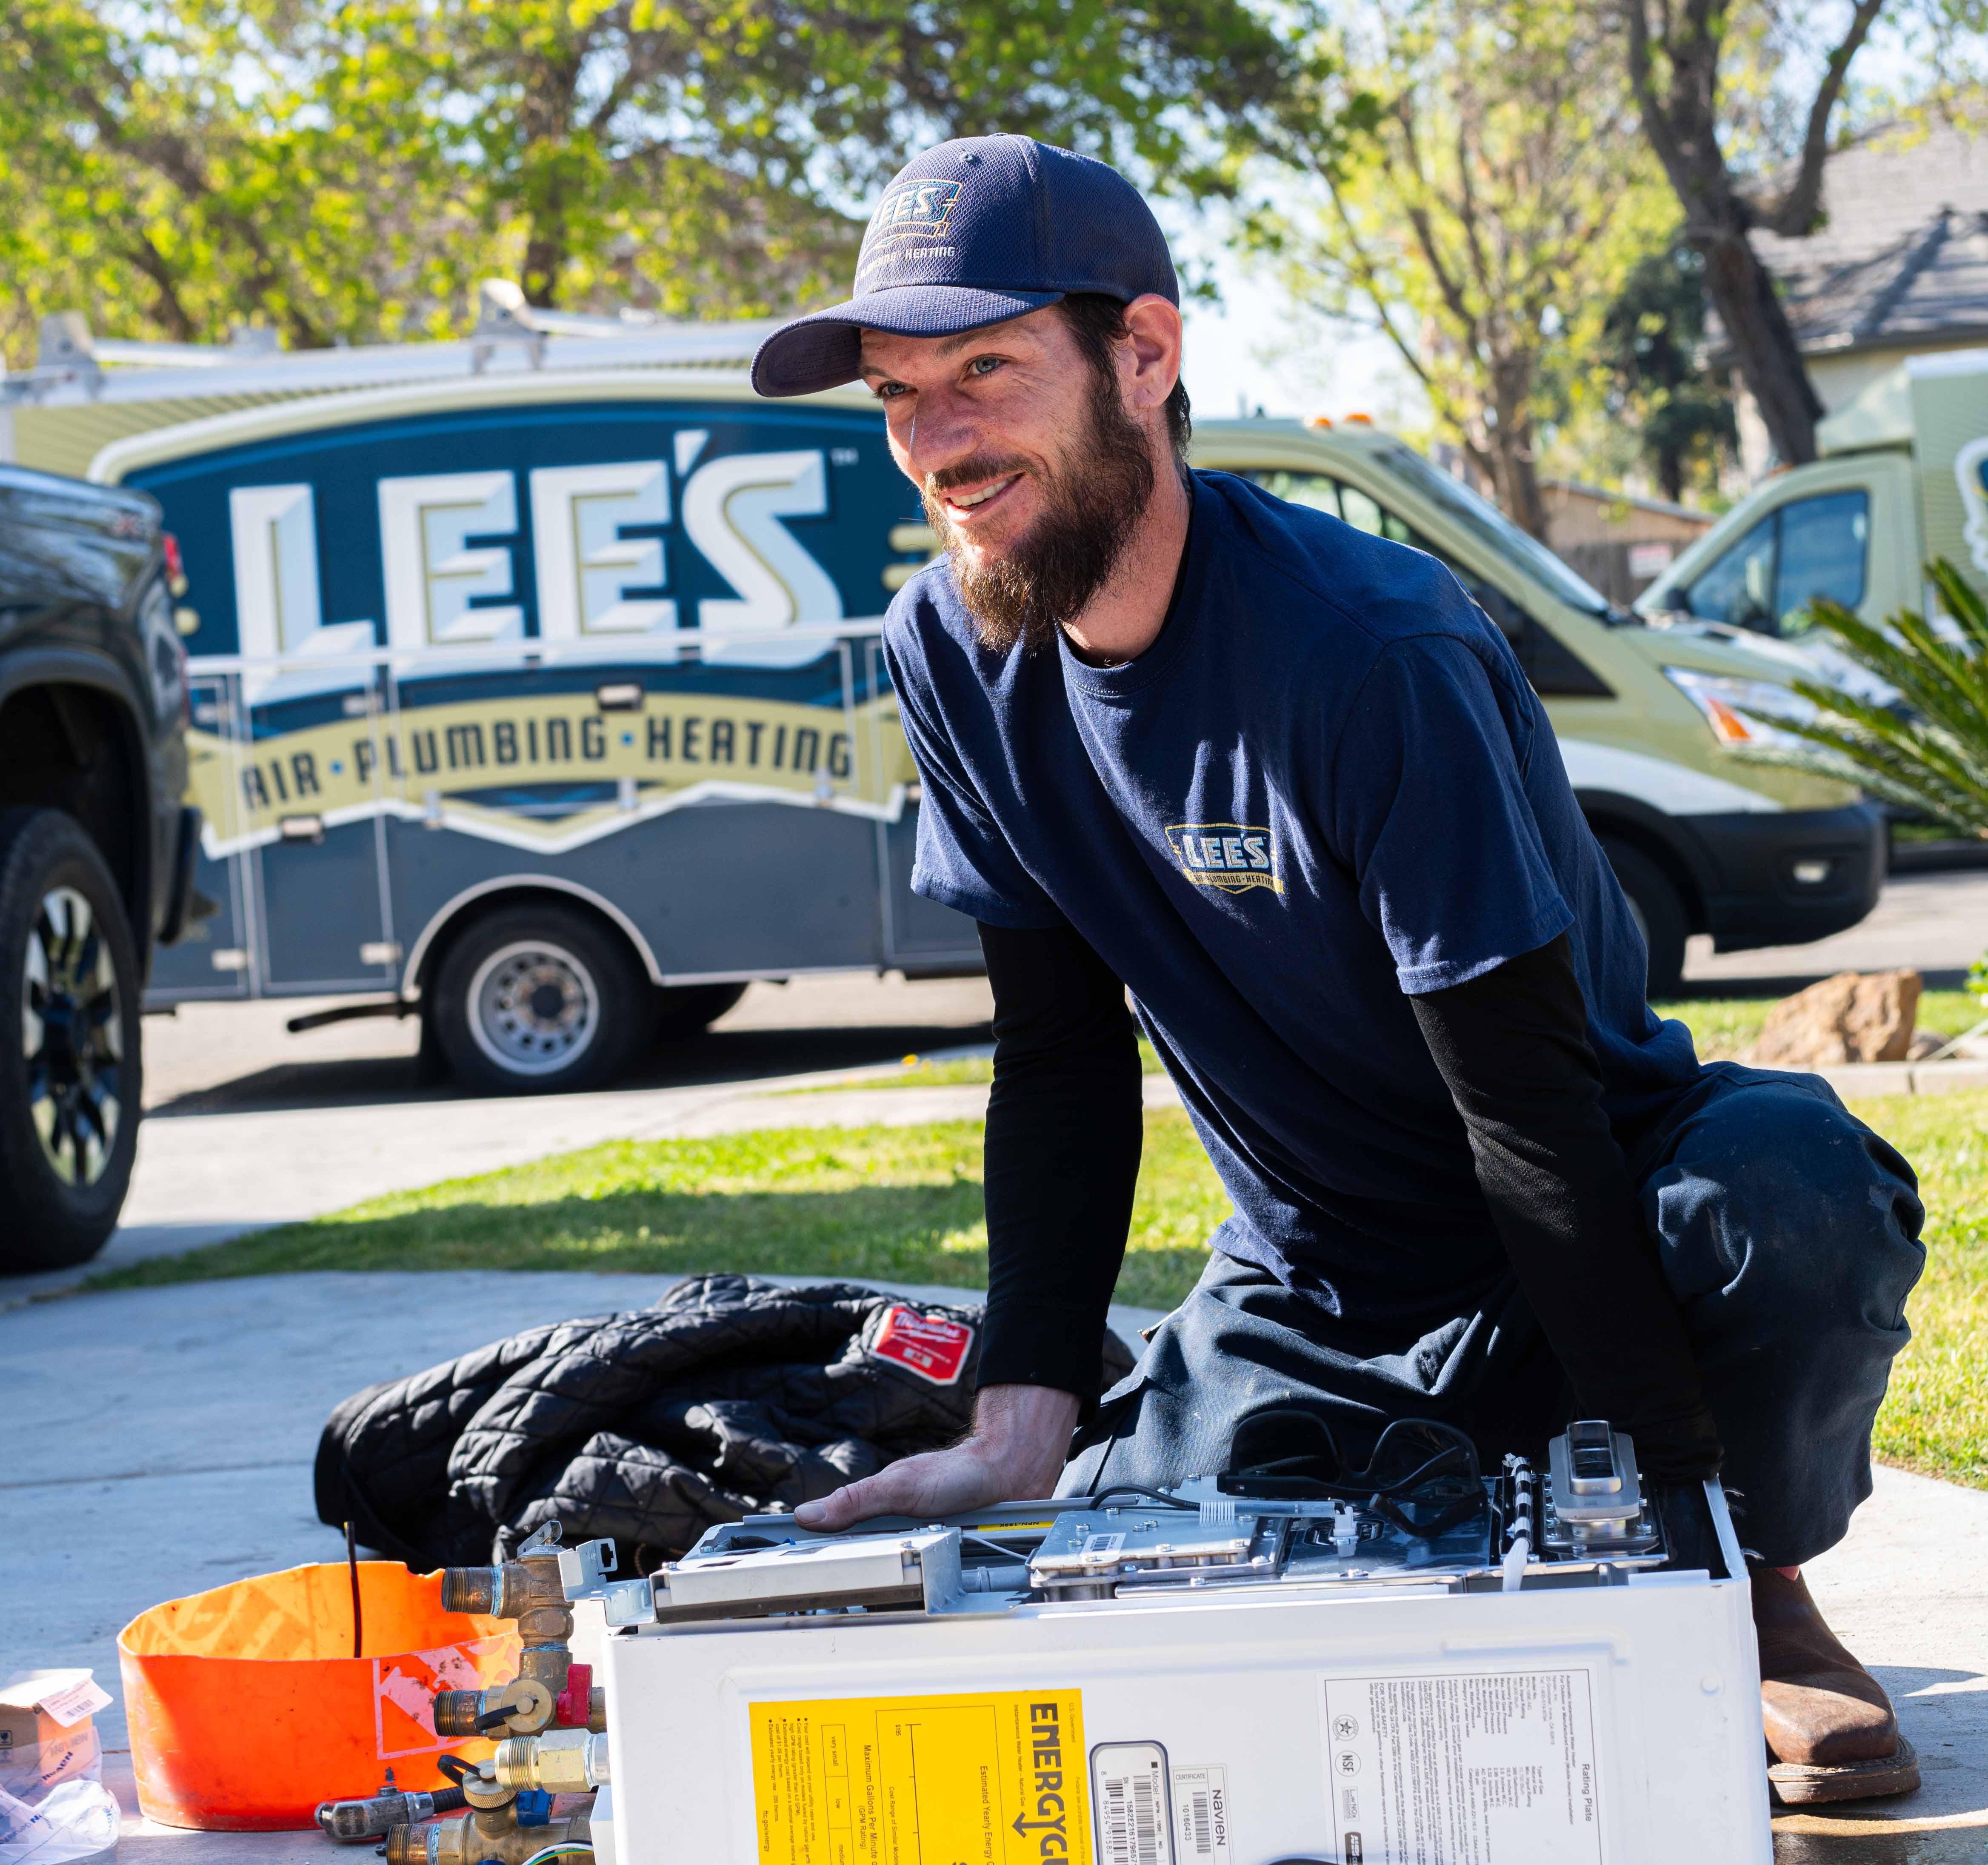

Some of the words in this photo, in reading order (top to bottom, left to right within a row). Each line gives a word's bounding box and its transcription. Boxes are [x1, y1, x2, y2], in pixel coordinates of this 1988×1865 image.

[905, 246, 956, 260] HEATING
[228, 428, 844, 707] LEE'S
[241, 751, 320, 811] AIR
[353, 714, 607, 786] PLUMBING
[646, 715, 853, 777] HEATING
[1183, 833, 1269, 869] LEE'S
[1246, 875, 1274, 888] HEATING
[863, 1745, 873, 1782] Maximum
[1341, 1754, 1354, 1772] NSF
[980, 1765, 990, 1804] Estimated
[1151, 1771, 1160, 1795] Model
[1580, 1763, 1591, 1795] Rating
[866, 1785, 875, 1814] Gallons
[1584, 1797, 1593, 1822] Plate
[857, 1805, 865, 1823] (GPM
[868, 1817, 877, 1830] Per
[981, 1806, 991, 1829] Yearly
[1182, 1804, 1191, 1841] 10160433
[761, 1810, 771, 1852] ftc.gov/energy
[858, 1825, 867, 1849] Rating)
[869, 1832, 879, 1859] Minute
[983, 1832, 994, 1859] Energy
